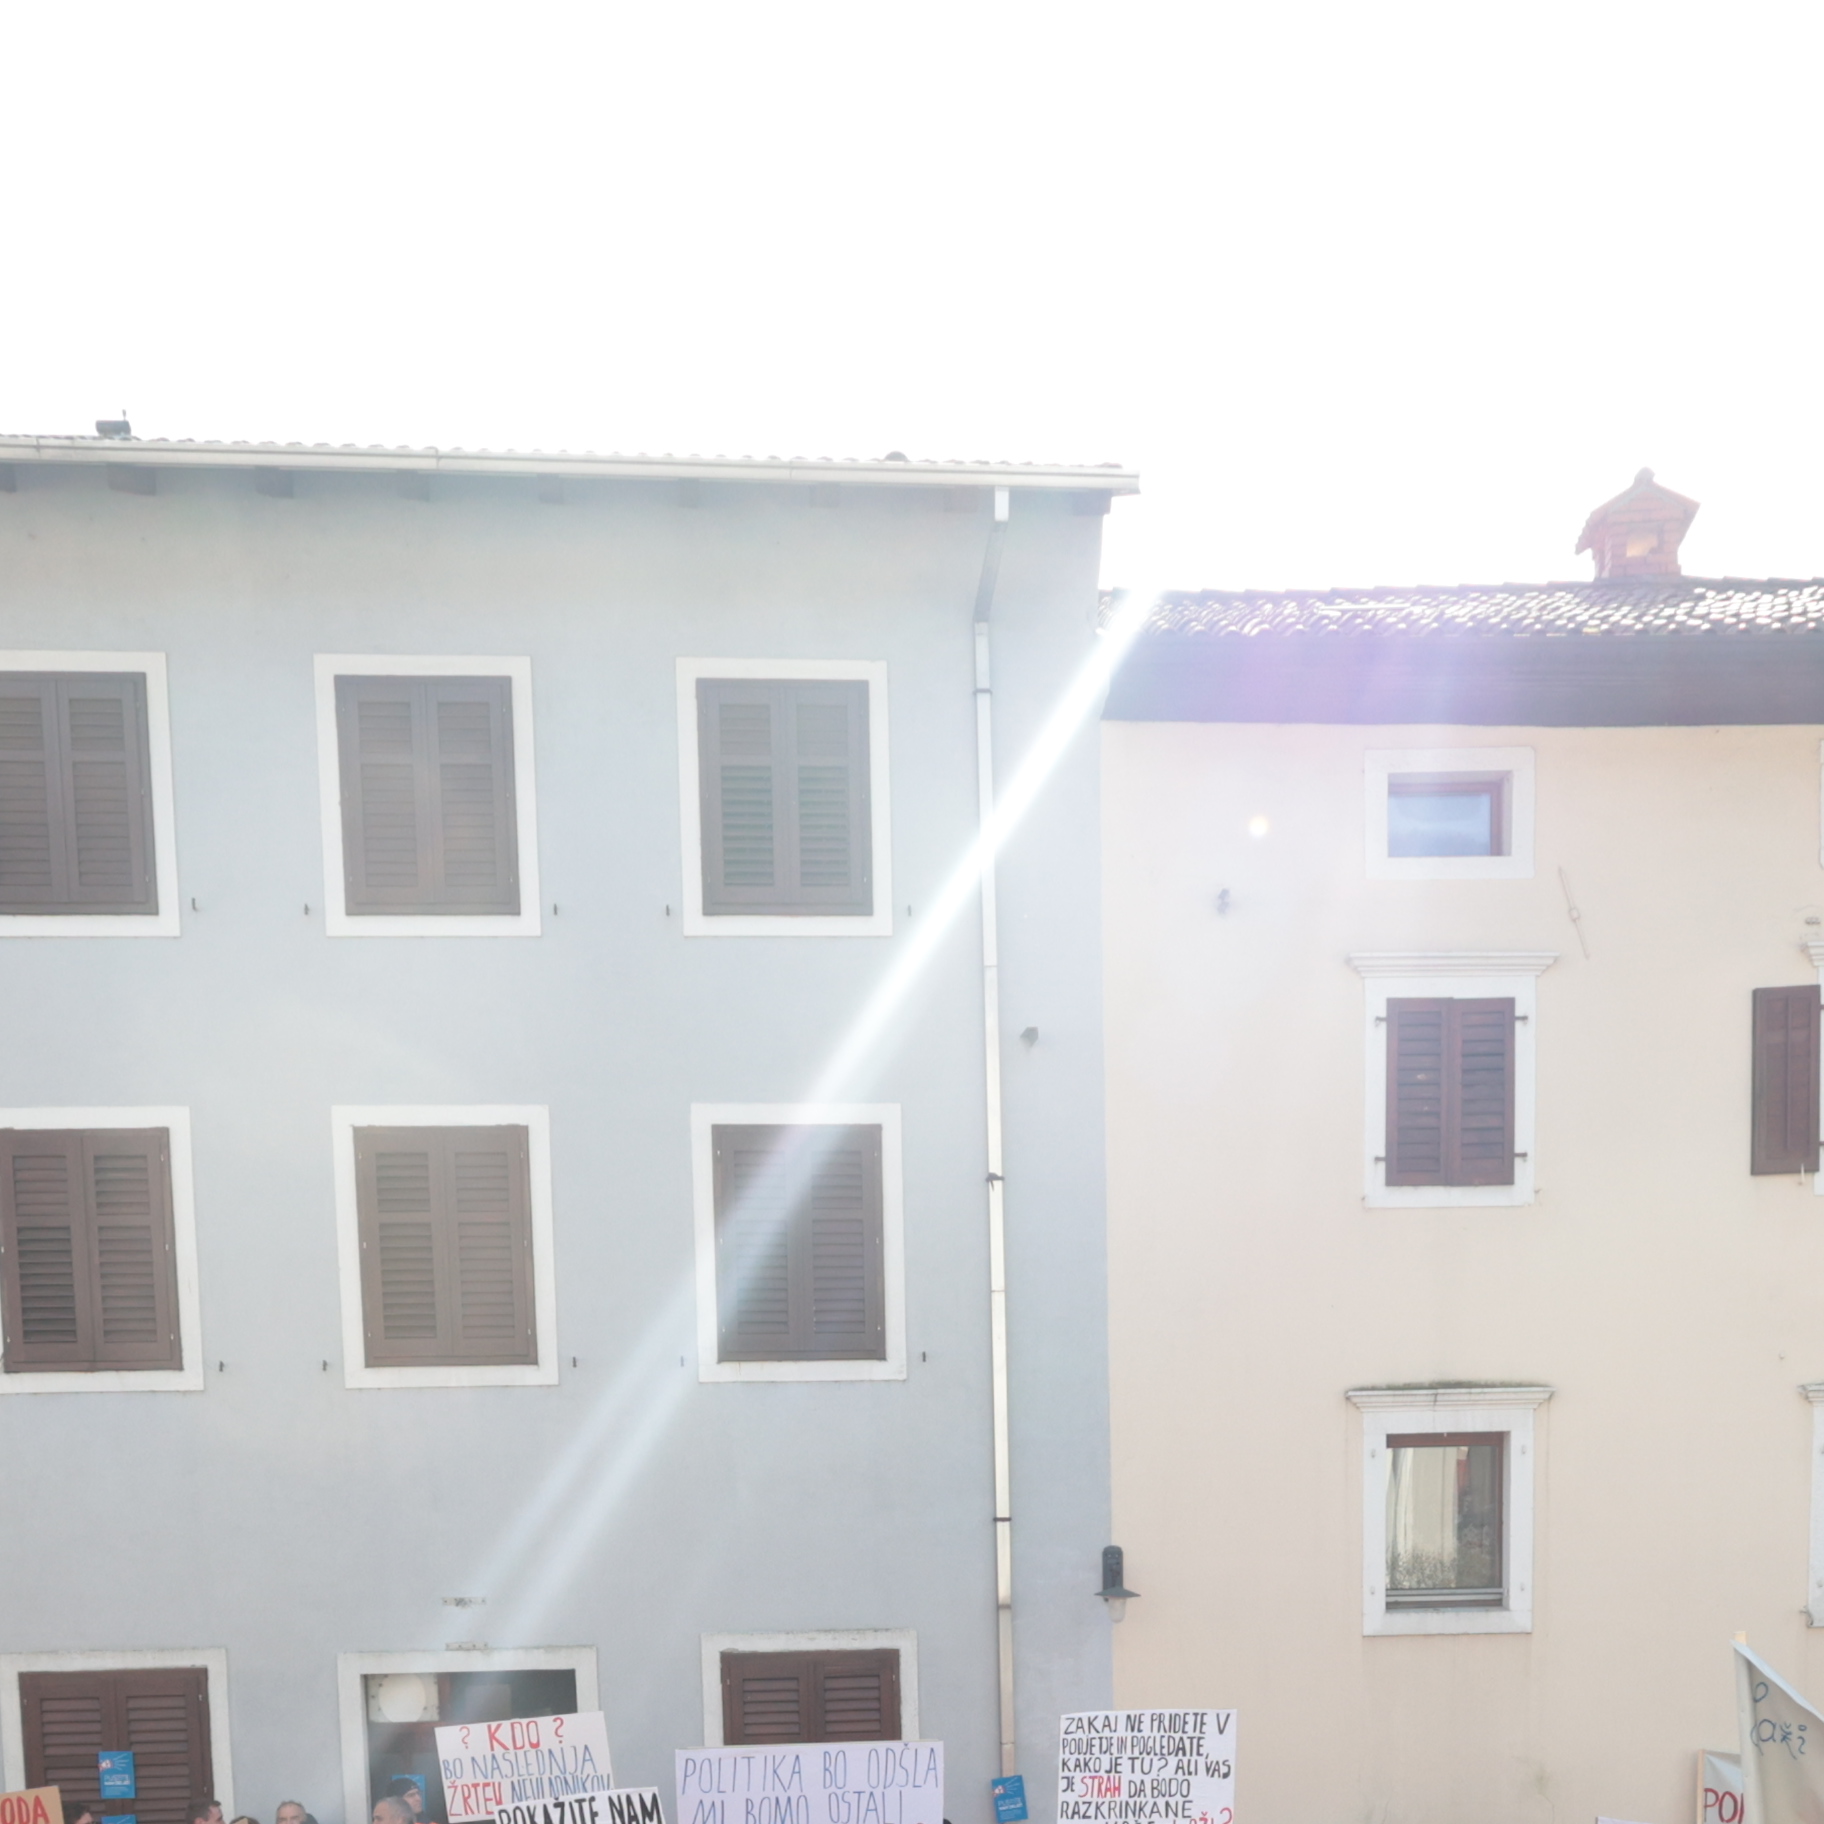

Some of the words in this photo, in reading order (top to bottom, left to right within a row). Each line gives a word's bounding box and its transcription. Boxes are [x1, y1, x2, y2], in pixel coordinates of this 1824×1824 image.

[1063, 1715, 1118, 1735] ZAKAJ
[1125, 1713, 1146, 1733] NE
[1150, 1712, 1208, 1735] PRIDETE
[1216, 1713, 1231, 1735] V
[486, 1720, 542, 1752] KDO
[1062, 1735, 1115, 1756] PODJETJE
[442, 1758, 464, 1780] BO
[470, 1743, 597, 1780] NASLEDNJA
[681, 1754, 804, 1796] POLITIKA
[822, 1749, 848, 1790] BO
[866, 1742, 939, 1789] ODŠLA
[1061, 1757, 1102, 1773] KAKO
[1104, 1756, 1123, 1774] JE
[1174, 1758, 1198, 1776] ALI
[1204, 1759, 1231, 1779] VAS
[447, 1779, 503, 1817] ŽRTEV
[1061, 1775, 1076, 1793] JE
[1078, 1775, 1122, 1799] STRAH
[1128, 1778, 1147, 1799] DA
[1150, 1778, 1191, 1799] BODO
[1060, 1800, 1194, 1820] RAZKRINKANE
